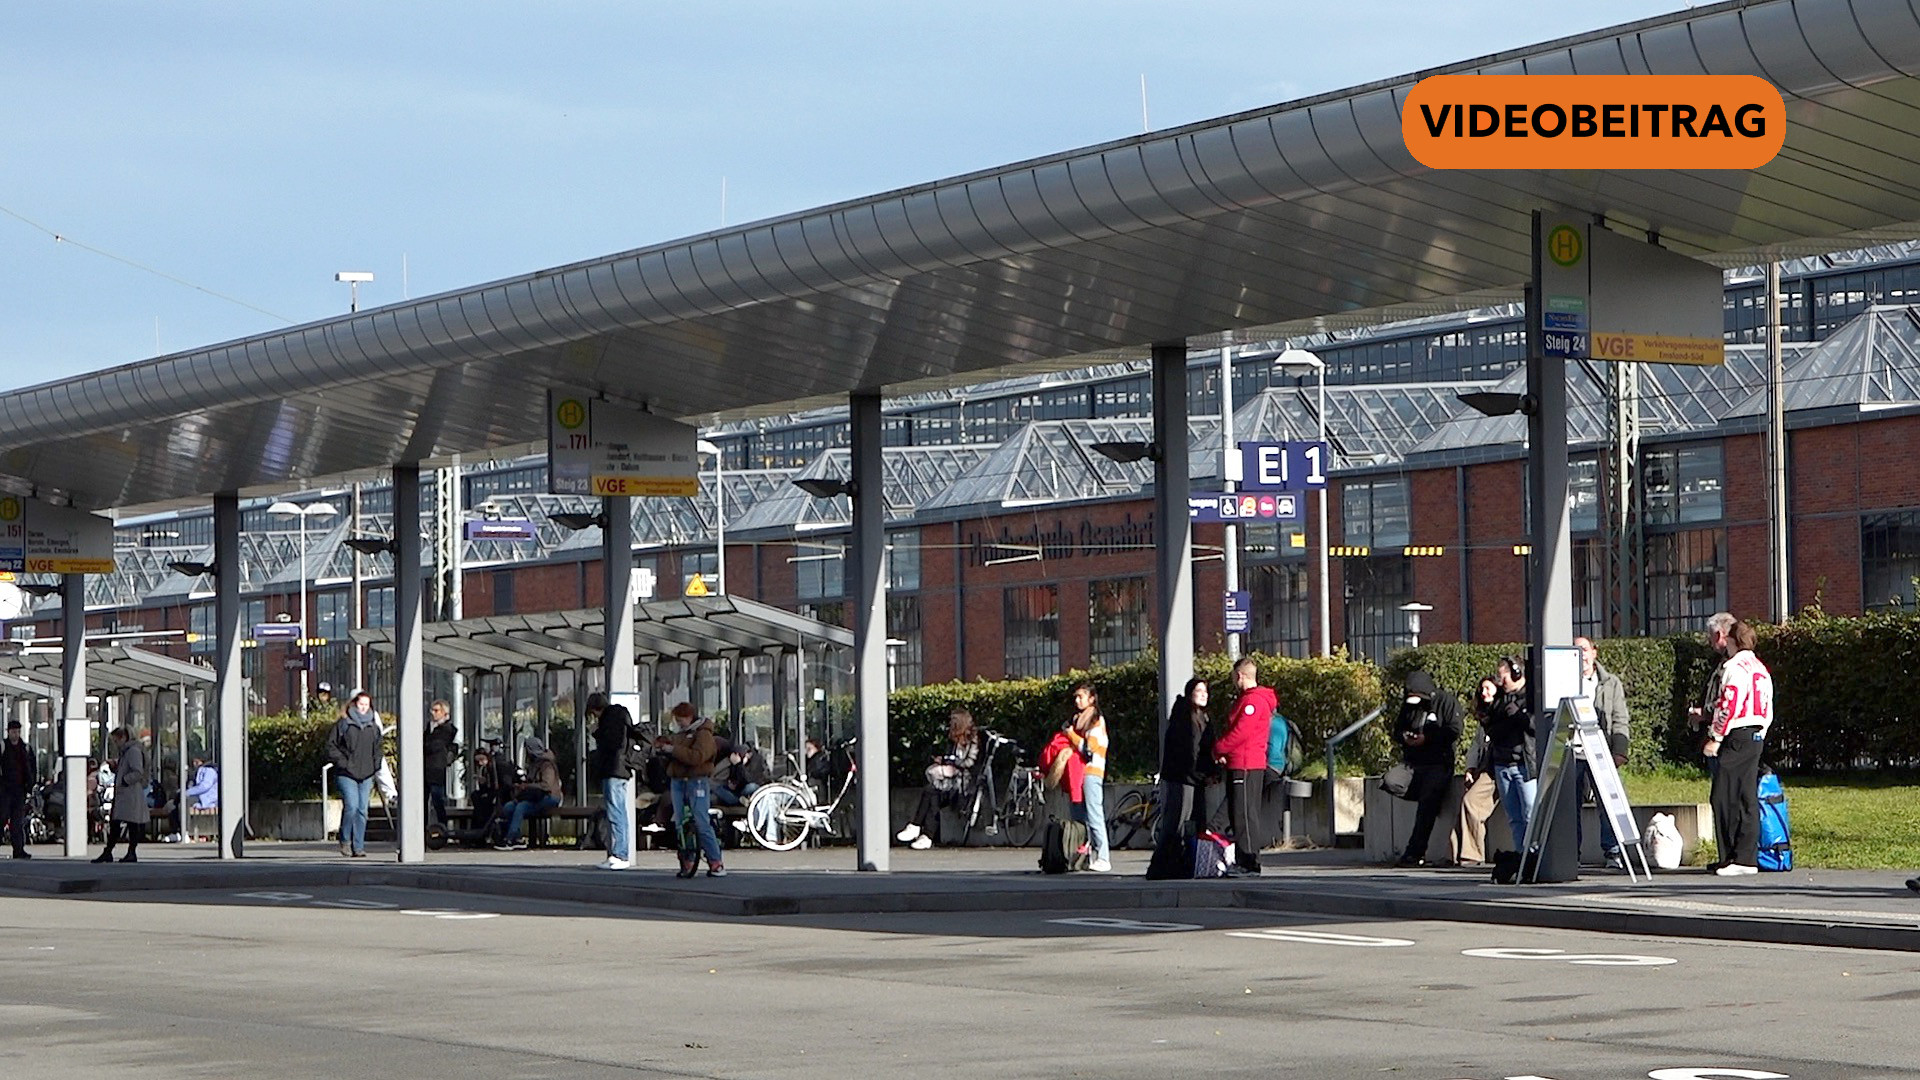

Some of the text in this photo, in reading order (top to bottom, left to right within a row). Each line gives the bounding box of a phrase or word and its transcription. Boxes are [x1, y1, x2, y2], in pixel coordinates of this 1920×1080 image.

[1558, 234, 1573, 258] H
[1546, 335, 1586, 353] Steig 24
[1597, 337, 1635, 357] VGE
[569, 434, 587, 450] 171
[556, 478, 588, 492] Steig 23
[597, 479, 626, 493] VGE
[7, 525, 21, 538] 151
[13, 561, 23, 570] 22
[29, 560, 54, 571] VGE
[1045, 918, 1677, 966] BUS
